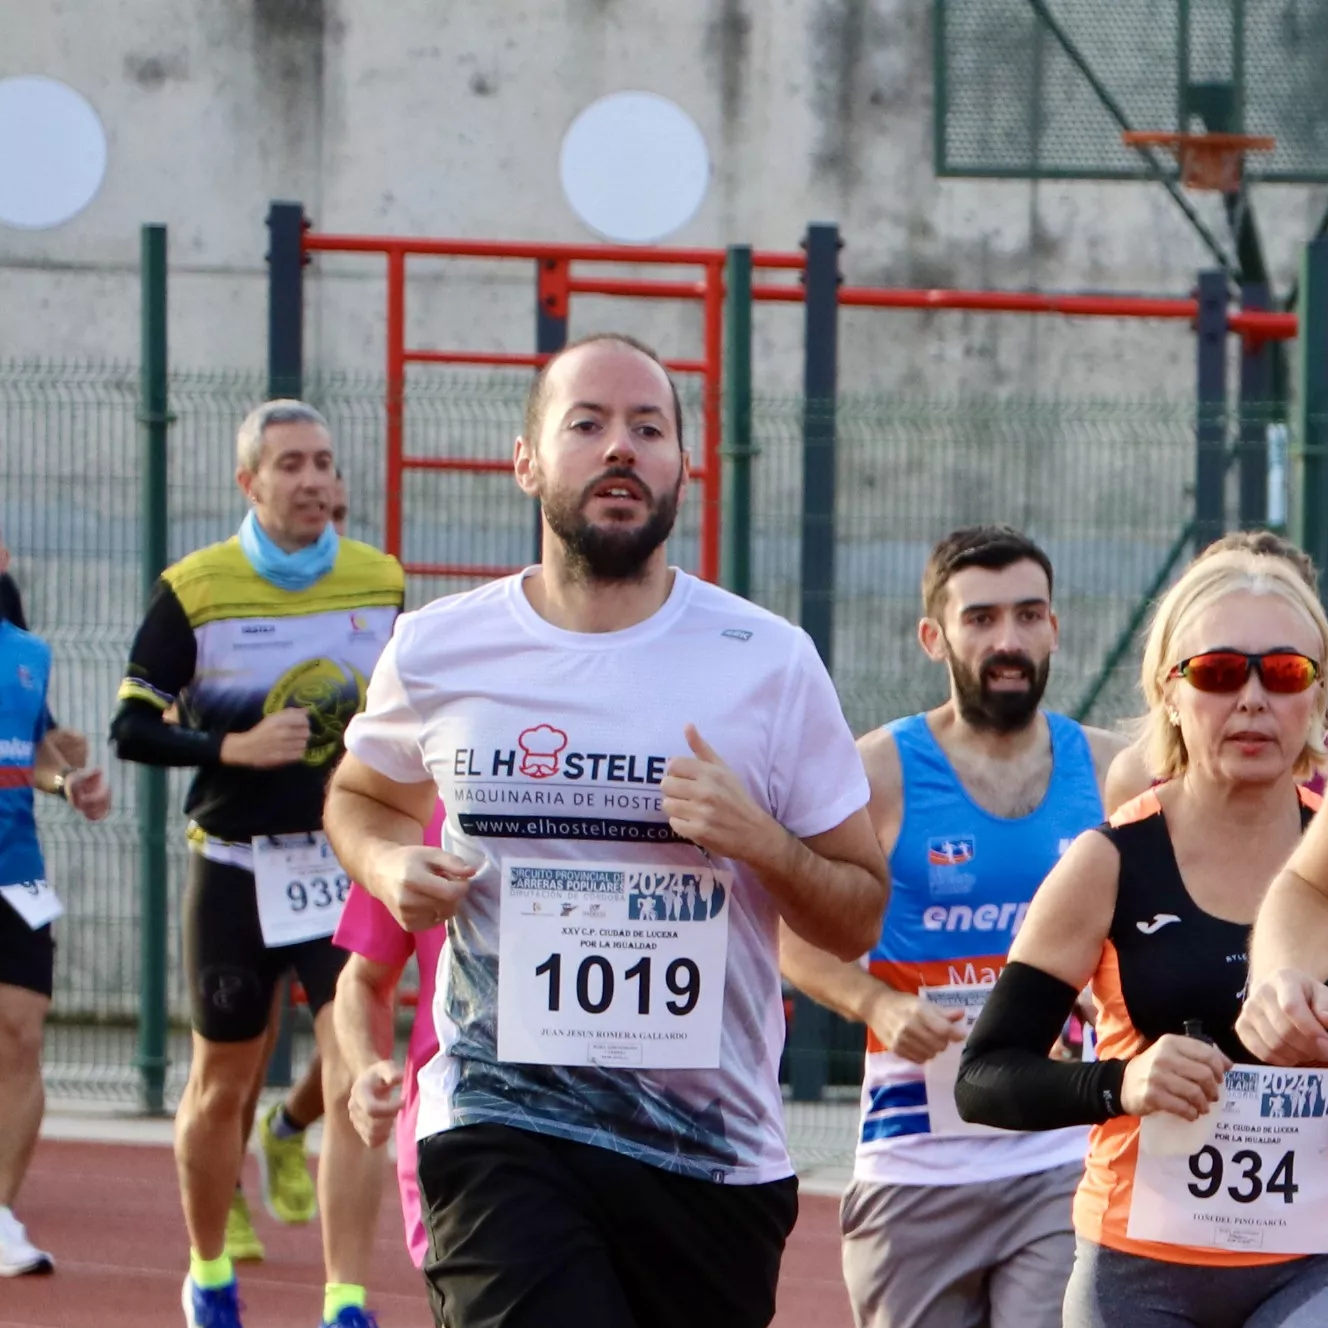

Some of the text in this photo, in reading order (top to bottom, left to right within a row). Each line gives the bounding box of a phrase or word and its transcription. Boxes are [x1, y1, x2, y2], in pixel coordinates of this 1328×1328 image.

[454, 749, 481, 776] EL
[454, 789, 662, 811] MAQUINARIA DE HOSTE
[555, 870, 612, 881] PROVINCIAL
[613, 873, 625, 881] DE
[628, 872, 684, 895] 2024
[286, 874, 350, 912] 938
[566, 881, 625, 893] POPULARES
[923, 902, 1030, 937] enerp
[561, 927, 580, 936] XXV
[599, 929, 631, 938] CIUDAD
[633, 929, 645, 938] DE
[646, 930, 678, 939] LUCENA
[580, 940, 658, 950] POR LA IGUALDAD
[535, 953, 701, 1016] 1019
[949, 963, 1001, 985] Ma
[541, 1029, 564, 1037] JUAN
[596, 1031, 637, 1040] ROMERA
[639, 1032, 688, 1041] GALLARDO
[1261, 1074, 1308, 1095] 2024
[1187, 1144, 1298, 1204] 934
